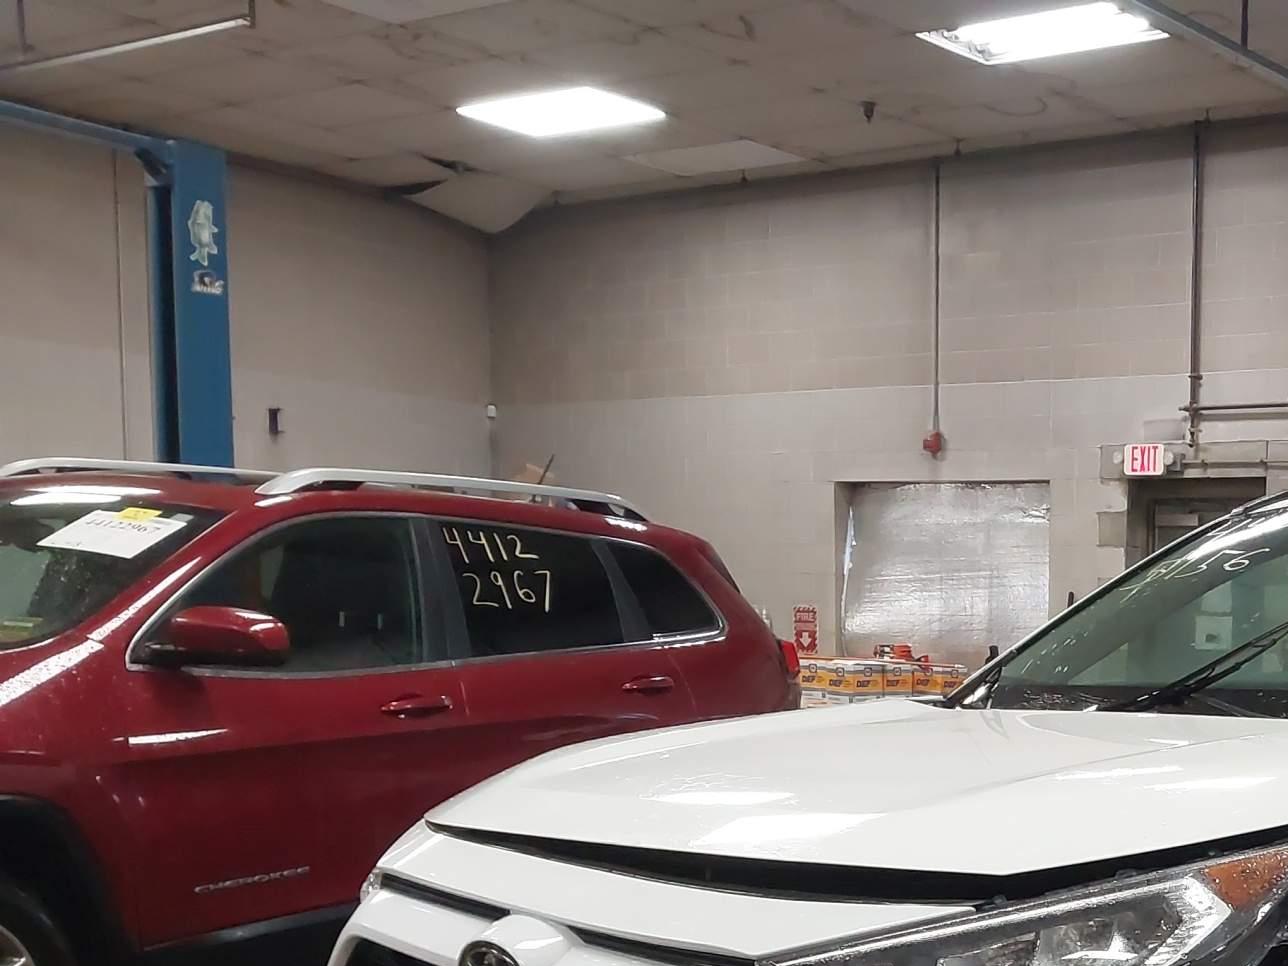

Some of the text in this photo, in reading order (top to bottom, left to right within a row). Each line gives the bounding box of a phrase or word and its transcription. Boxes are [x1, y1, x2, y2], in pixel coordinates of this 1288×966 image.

[1131, 446, 1158, 473] EXIT
[442, 527, 539, 563] 4412
[462, 570, 550, 613] 2967
[797, 613, 815, 621] FIRE
[194, 866, 310, 893] CHEROKEE
